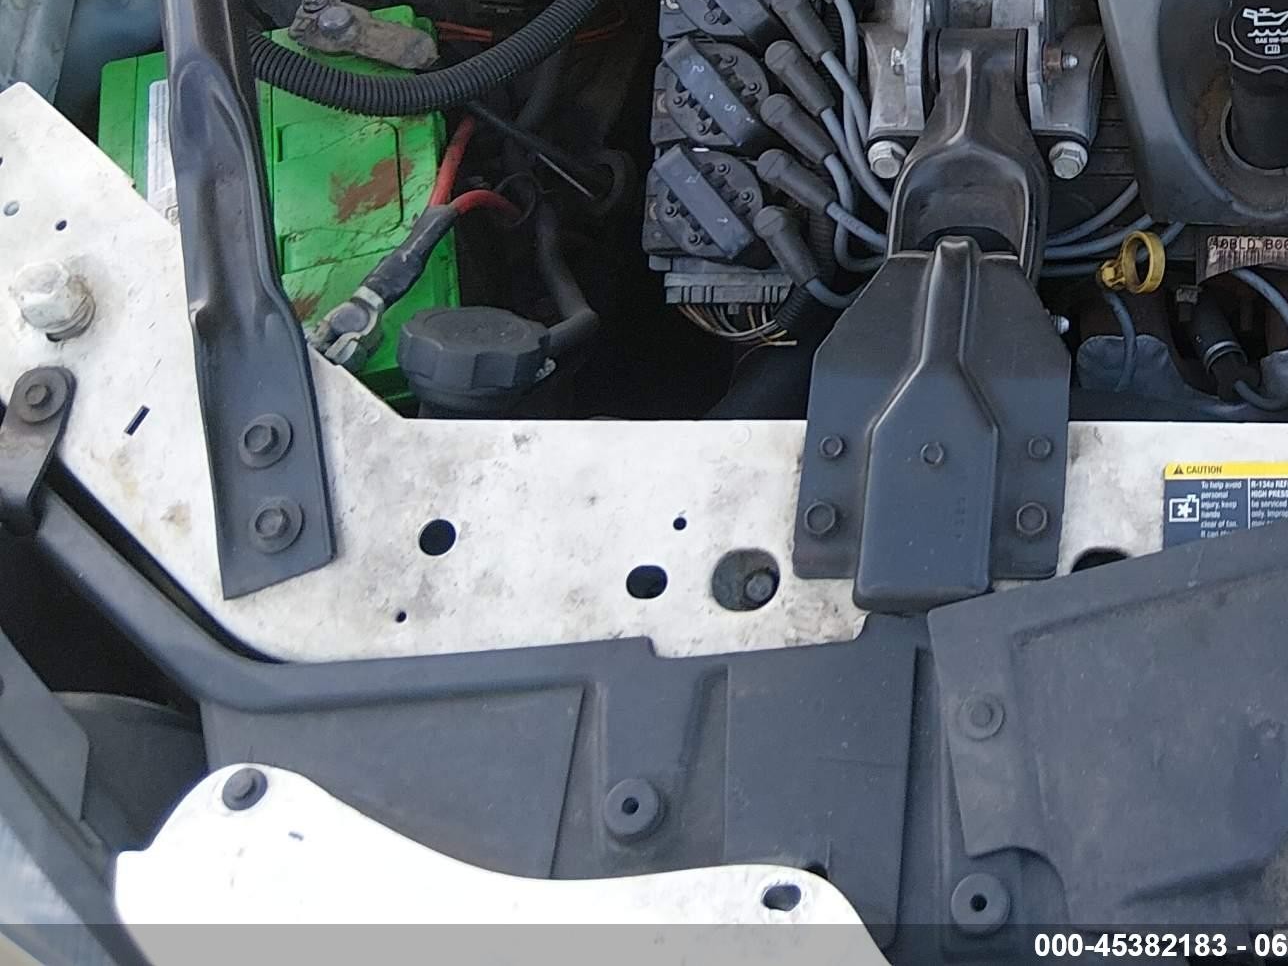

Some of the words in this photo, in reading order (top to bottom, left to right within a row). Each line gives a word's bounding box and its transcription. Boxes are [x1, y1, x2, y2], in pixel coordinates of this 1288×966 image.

[1186, 465, 1222, 474] CAUTION
[1201, 481, 1209, 489] To
[1210, 481, 1224, 490] help
[1225, 481, 1242, 489] avoid
[1251, 480, 1275, 488] R-134a
[1201, 490, 1229, 500] personal
[1251, 490, 1267, 498] HIGH
[1221, 501, 1238, 509] keep
[1251, 500, 1260, 508] be
[1260, 500, 1287, 508] serviced
[1218, 520, 1225, 528] of
